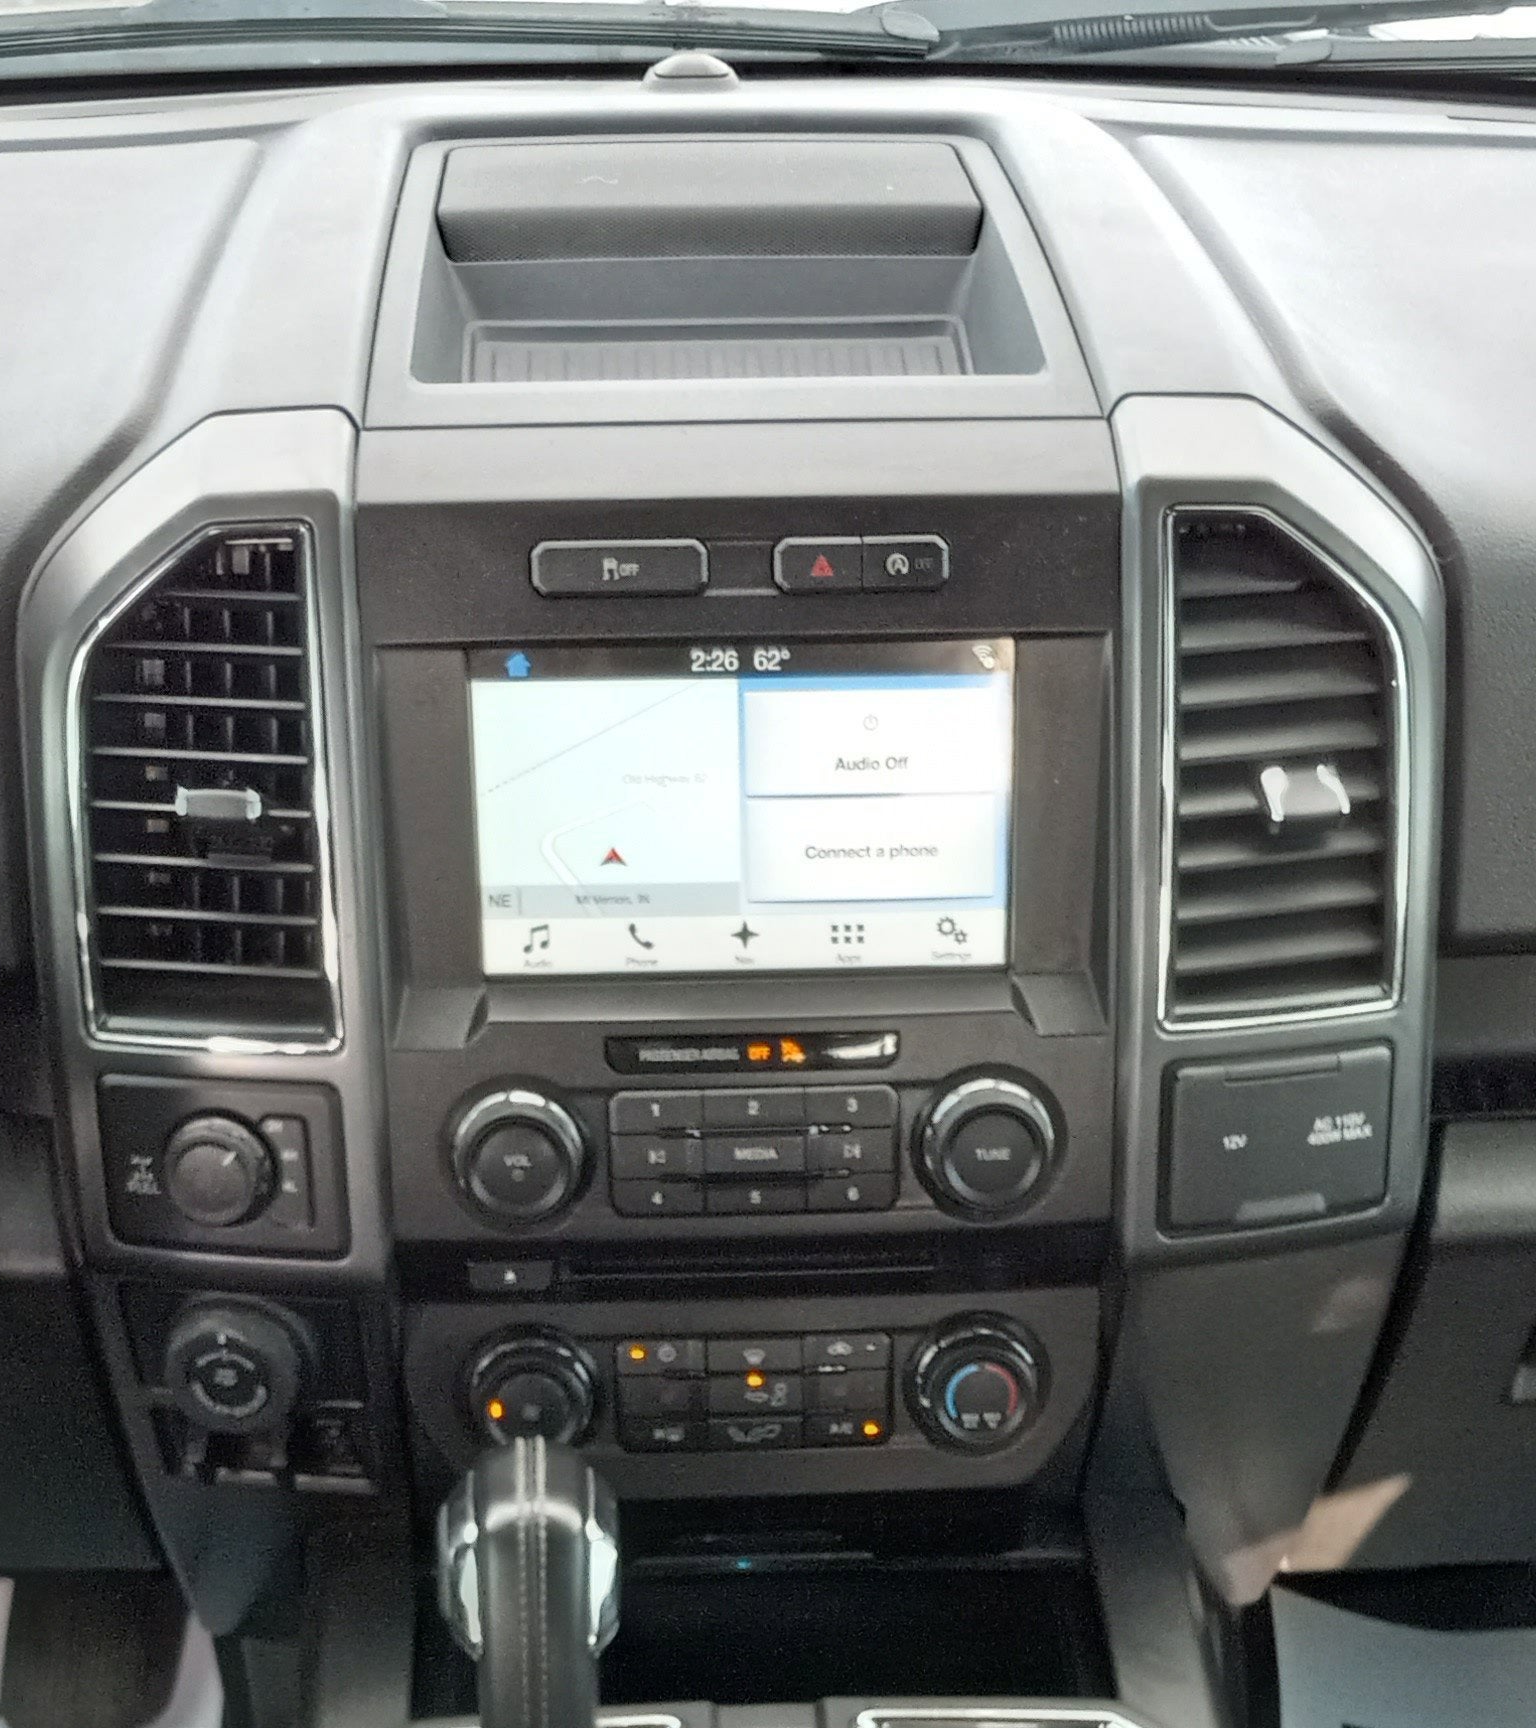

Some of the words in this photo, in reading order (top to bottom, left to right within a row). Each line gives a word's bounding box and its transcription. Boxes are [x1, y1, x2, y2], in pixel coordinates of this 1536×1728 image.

[619, 563, 640, 577] OFF
[690, 648, 739, 672] 2:26
[753, 647, 791, 672] 62°
[835, 757, 880, 772] Audio
[885, 756, 909, 771] Off
[805, 845, 871, 860] Connect
[889, 845, 939, 861] phone
[489, 893, 512, 909] NE
[651, 1103, 660, 1117] 1
[748, 1100, 760, 1116] 2
[846, 1097, 858, 1113] 3
[734, 1148, 779, 1160] MEDIA
[975, 1148, 1011, 1161] TUNE
